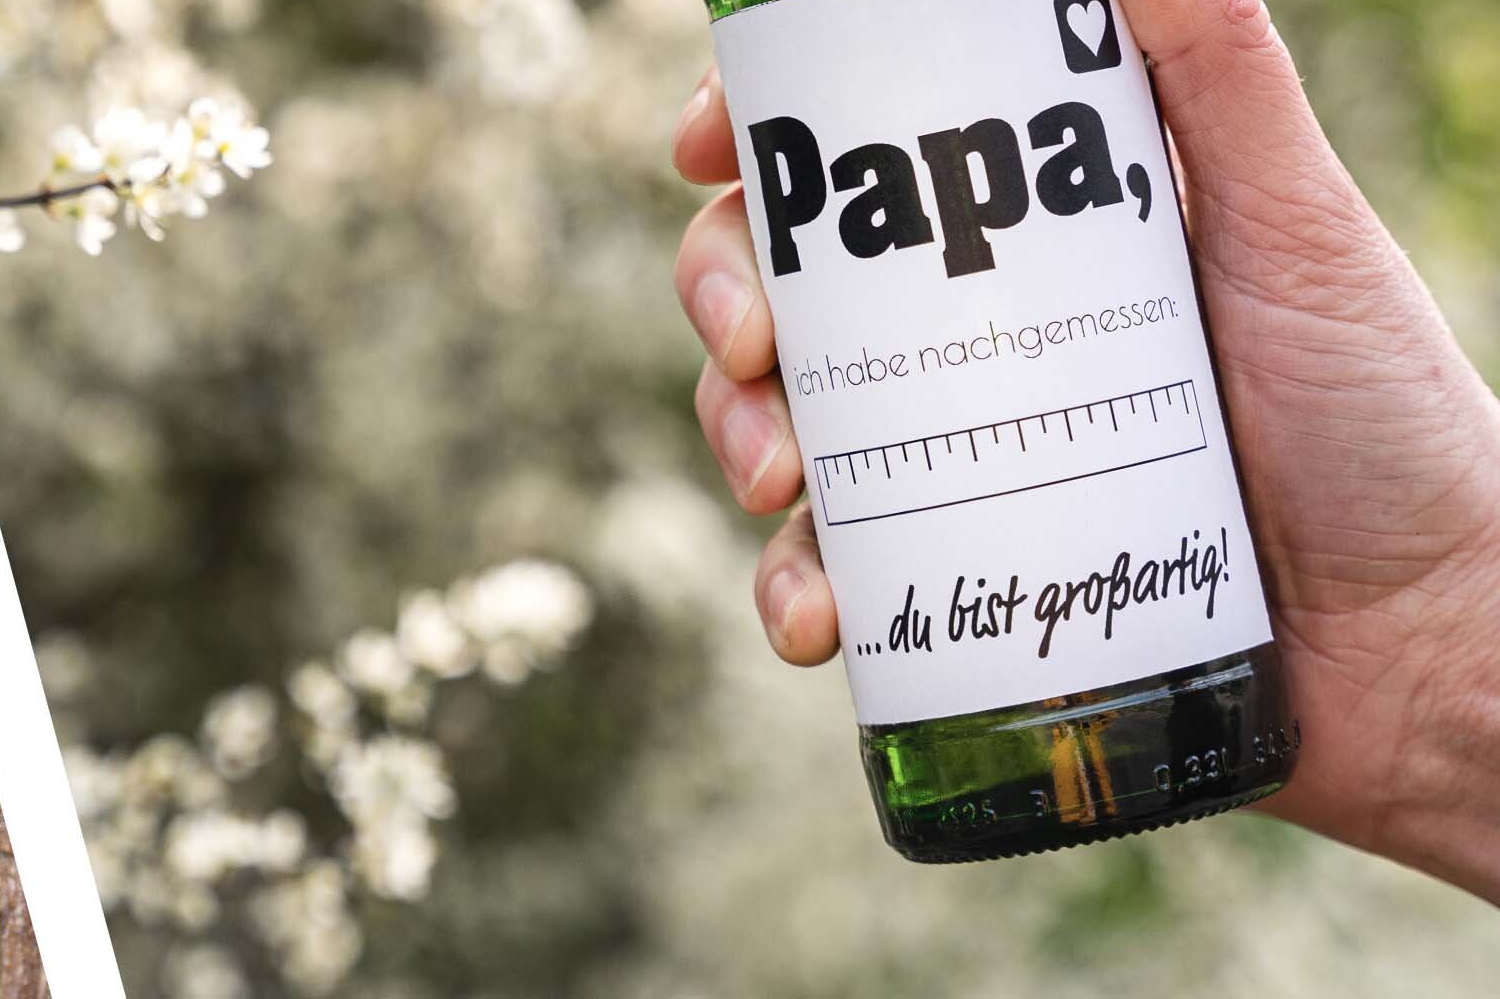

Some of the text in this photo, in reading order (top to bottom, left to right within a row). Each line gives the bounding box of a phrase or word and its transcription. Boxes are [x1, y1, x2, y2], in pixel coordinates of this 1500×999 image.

[748, 101, 1152, 279] Papa,
[794, 296, 1179, 397] ich habe nachgemessen:
[948, 575, 1029, 642] bist
[1034, 527, 1230, 659] großartig!
